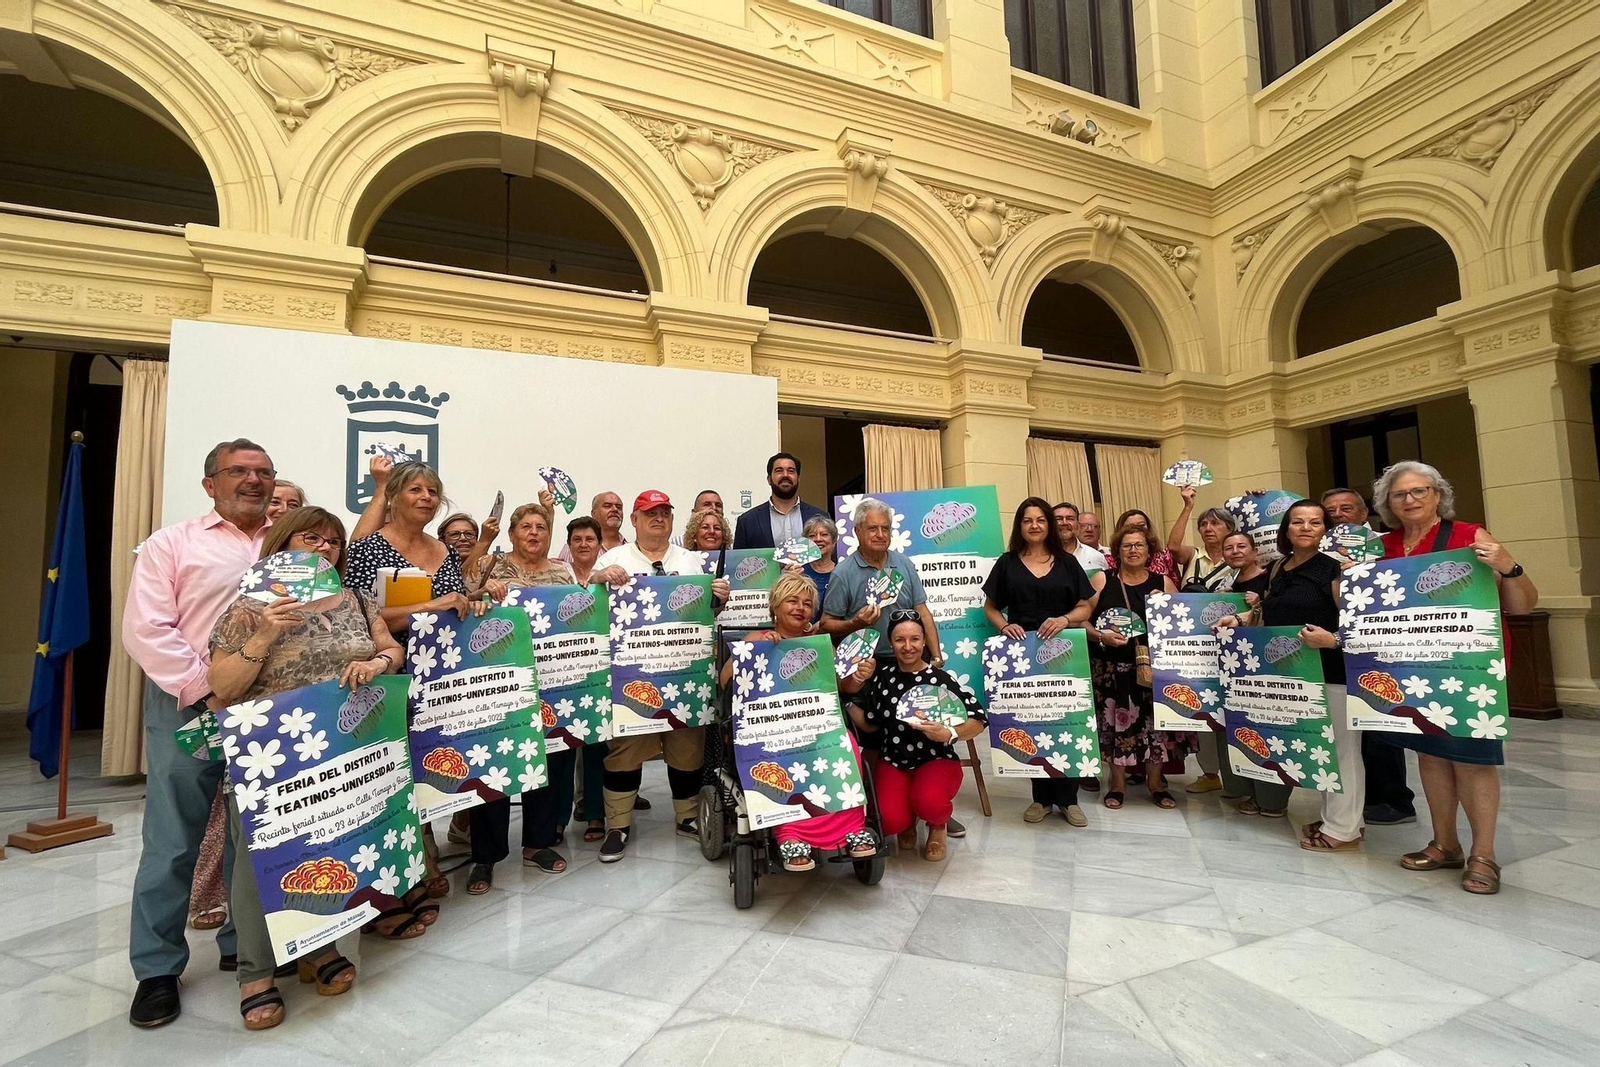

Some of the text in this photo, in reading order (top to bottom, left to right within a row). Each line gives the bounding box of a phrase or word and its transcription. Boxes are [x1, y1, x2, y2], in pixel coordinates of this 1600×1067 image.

[922, 560, 976, 571] DISTRITO 11
[922, 576, 983, 587] NIVERSIDAD
[929, 595, 947, 603] Calle
[948, 594, 975, 604] Tamayo
[944, 608, 962, 616] 2023
[1363, 615, 1389, 623] FERIA
[1393, 614, 1410, 622] DEL
[1414, 612, 1456, 621] DISTRITO
[630, 629, 650, 637] FERIA
[668, 627, 693, 635] DISTRITO
[1358, 625, 1474, 635] TEATINOS-UNIVERSIDAD
[559, 638, 588, 647] DISTRITO
[627, 639, 702, 649] TEATINOS-UNIVERSIDAD
[1416, 639, 1434, 647] Calle
[1436, 639, 1464, 650] Tamayo
[1466, 641, 1471, 649] y
[1413, 651, 1428, 660] julio
[1430, 651, 1449, 659] 2023
[430, 681, 450, 692] FERIA
[453, 678, 467, 687] DEL
[470, 672, 506, 685] DISTRITO
[1236, 679, 1252, 687] FERIA
[1267, 682, 1295, 690] DISTRITO
[427, 683, 520, 708] TEATINOS-UNIVERSIDAD
[1000, 690, 1076, 699] TEATINOS-UNIVERSIDAD
[1234, 690, 1308, 702] TEATINOS-UNIVERSIDAD
[476, 704, 490, 712] Calle
[491, 700, 514, 711] Tamayo
[748, 701, 767, 711] FERIA
[769, 700, 782, 709] DEL
[784, 698, 813, 707] DISTRITO
[467, 718, 473, 726] de
[747, 708, 825, 725] TEATINOS-UNIVERSIDAD
[277, 747, 388, 796] FERIA DEL DISTRITO 11
[275, 762, 395, 816] TEATINOS-UNIVERSIDAD
[258, 826, 291, 842] Recinto
[292, 817, 316, 835] ferial
[318, 805, 345, 822] situado
[347, 802, 355, 810] en
[355, 793, 372, 807] Calle
[372, 783, 392, 799] Tamayo
[314, 827, 326, 840] 20
[328, 826, 334, 834] a
[335, 821, 346, 832] 23
[347, 816, 356, 826] de
[356, 809, 371, 826] julio
[300, 923, 339, 945] Ayuntamiento
[348, 910, 365, 922] Málaga
